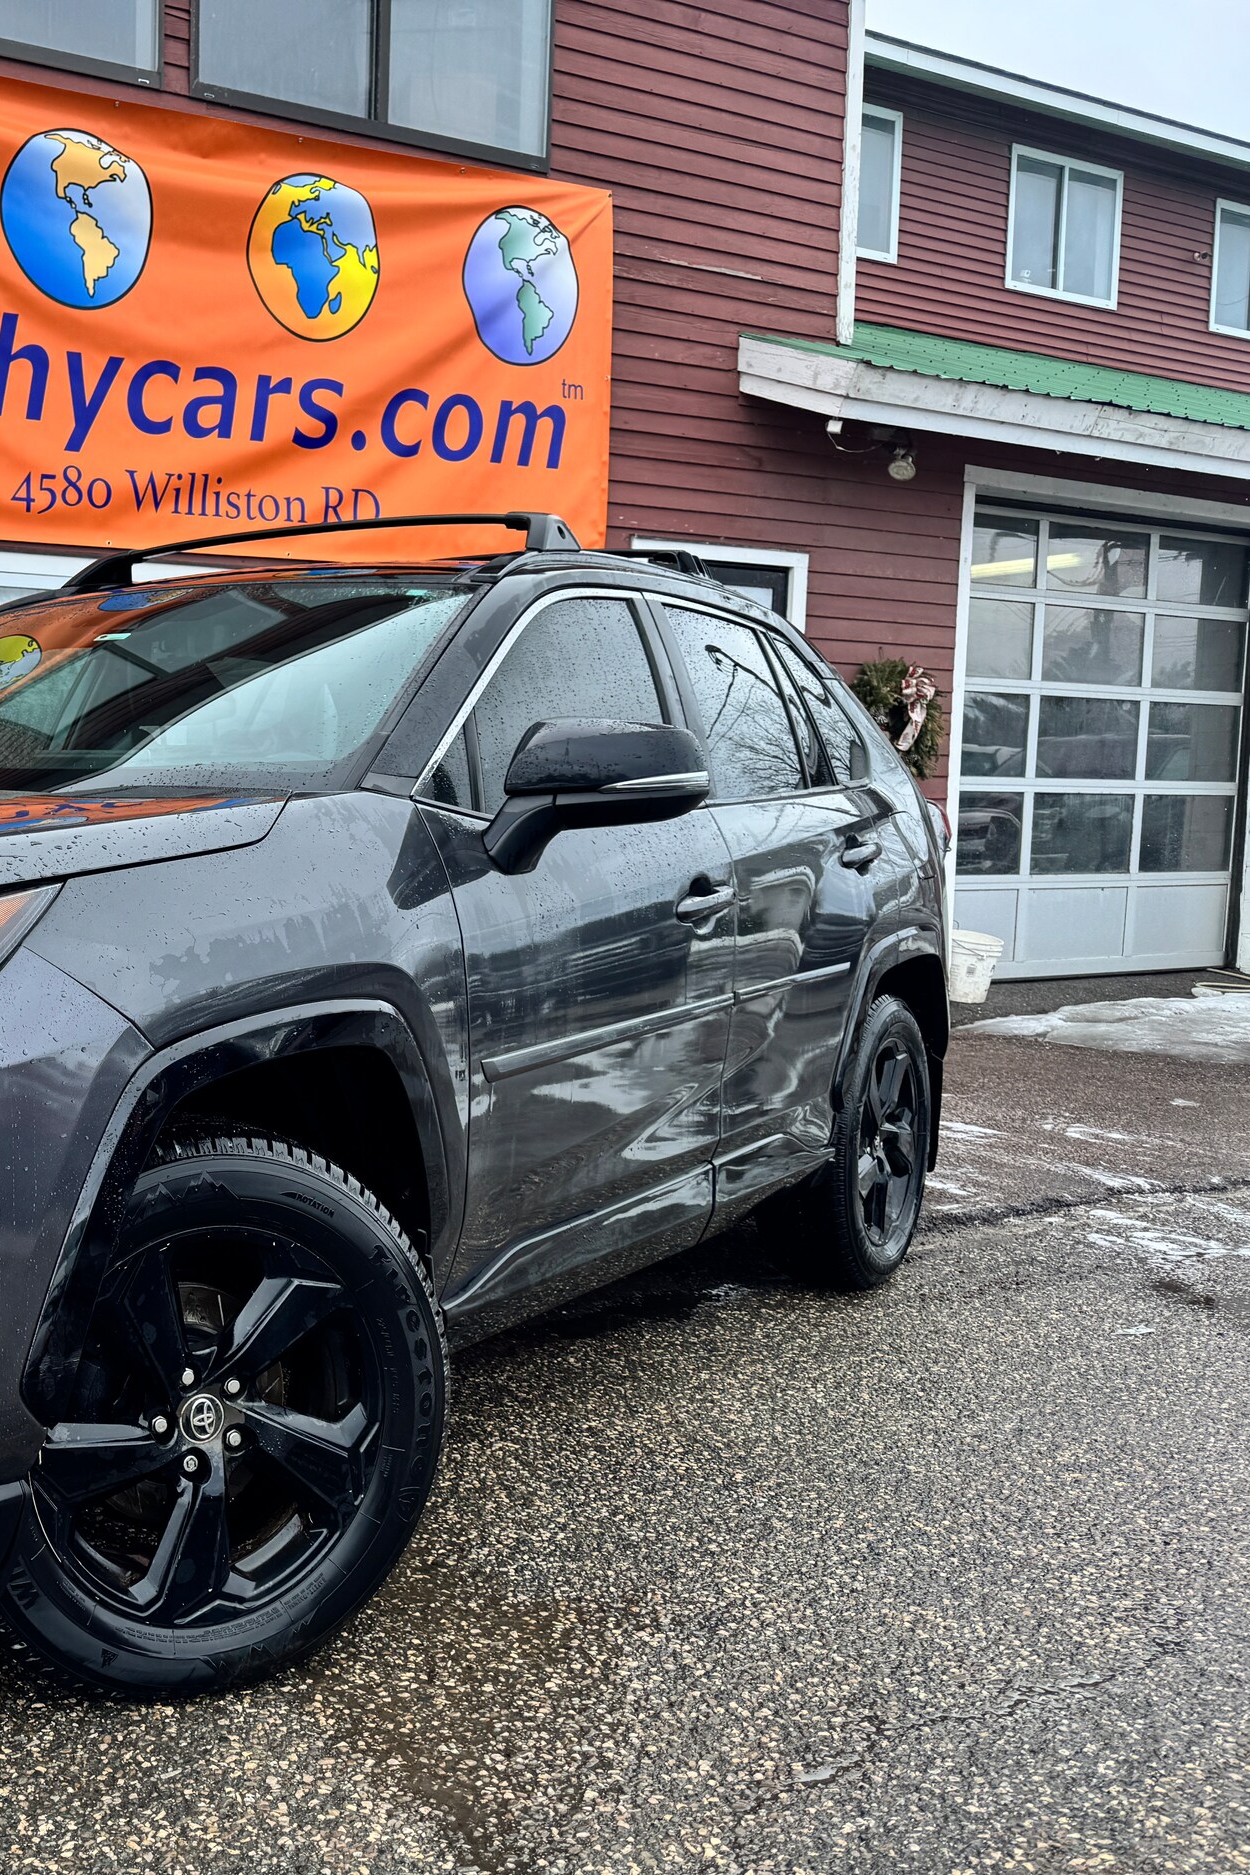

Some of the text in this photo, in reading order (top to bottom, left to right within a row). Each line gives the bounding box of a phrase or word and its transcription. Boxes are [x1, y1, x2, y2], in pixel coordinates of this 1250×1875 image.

[561, 378, 584, 401] tm
[10, 465, 381, 523] 4580 Williston RD
[296, 1194, 335, 1218] ROTATION
[368, 1244, 433, 1478] Firestone
